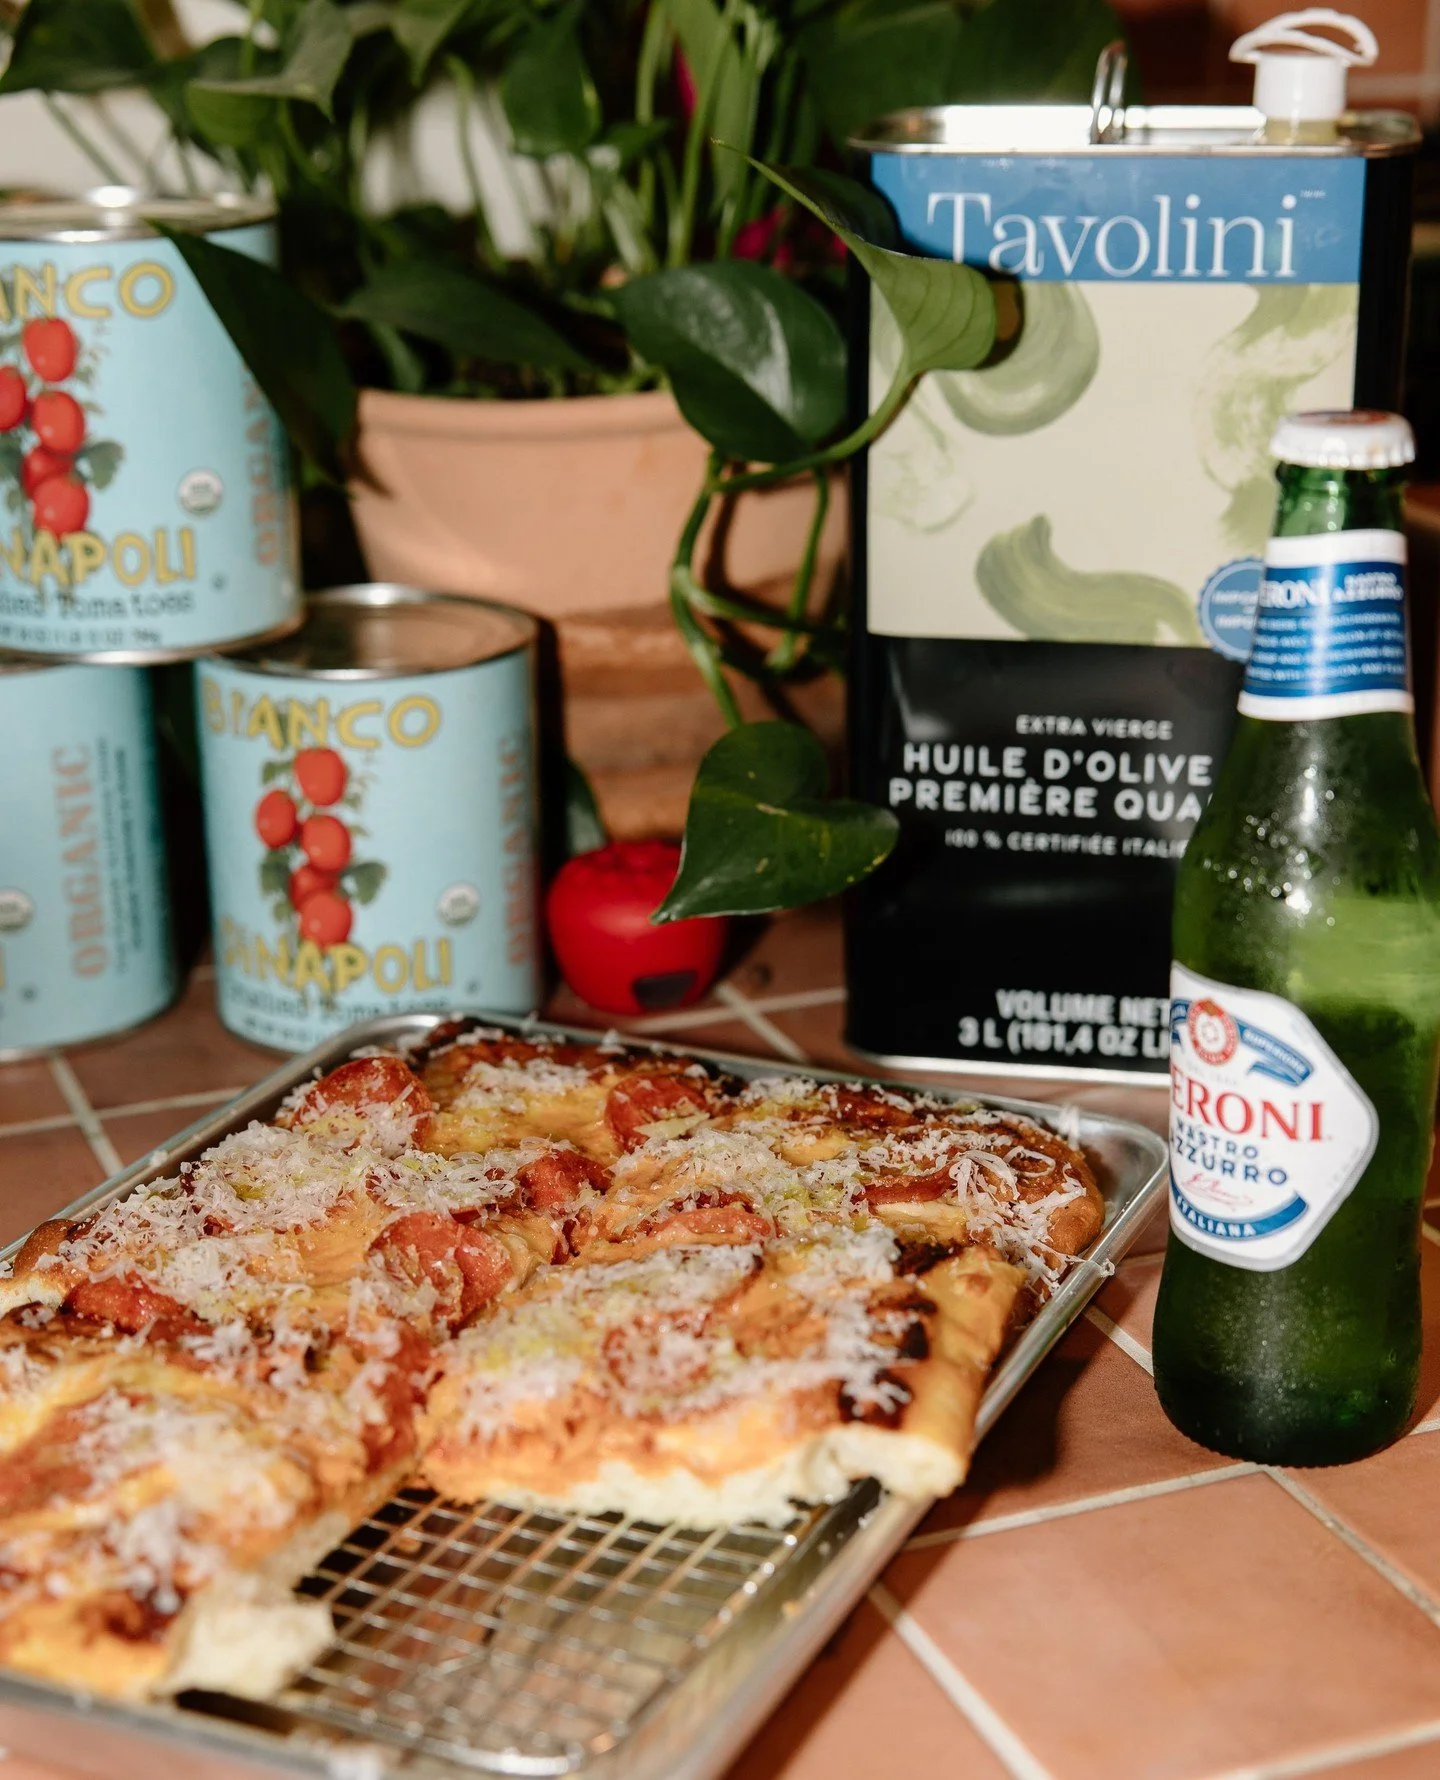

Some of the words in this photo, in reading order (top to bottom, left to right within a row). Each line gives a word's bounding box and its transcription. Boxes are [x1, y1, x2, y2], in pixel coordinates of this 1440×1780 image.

[927, 191, 1298, 277] Tavolini
[203, 678, 442, 751] BIANCO
[1015, 714, 1087, 736] EXTRA
[1091, 718, 1173, 740] VIERGE
[903, 742, 1027, 778] HUILE
[1043, 748, 1213, 787] D'OLIVE
[888, 777, 1098, 818] PREMIÈRE
[1114, 788, 1213, 821] QUA
[54, 743, 109, 980] ORGANIC
[945, 828, 978, 849] 100
[982, 830, 1002, 849] %
[1006, 830, 1117, 855] CERTIFIÉE
[995, 988, 1115, 1025] VOLUME
[1119, 997, 1170, 1027] NET
[958, 1016, 980, 1047] 3
[983, 1017, 1002, 1048] L
[1098, 1024, 1139, 1056] OZ
[1176, 1194, 1258, 1237] ITALIANA
